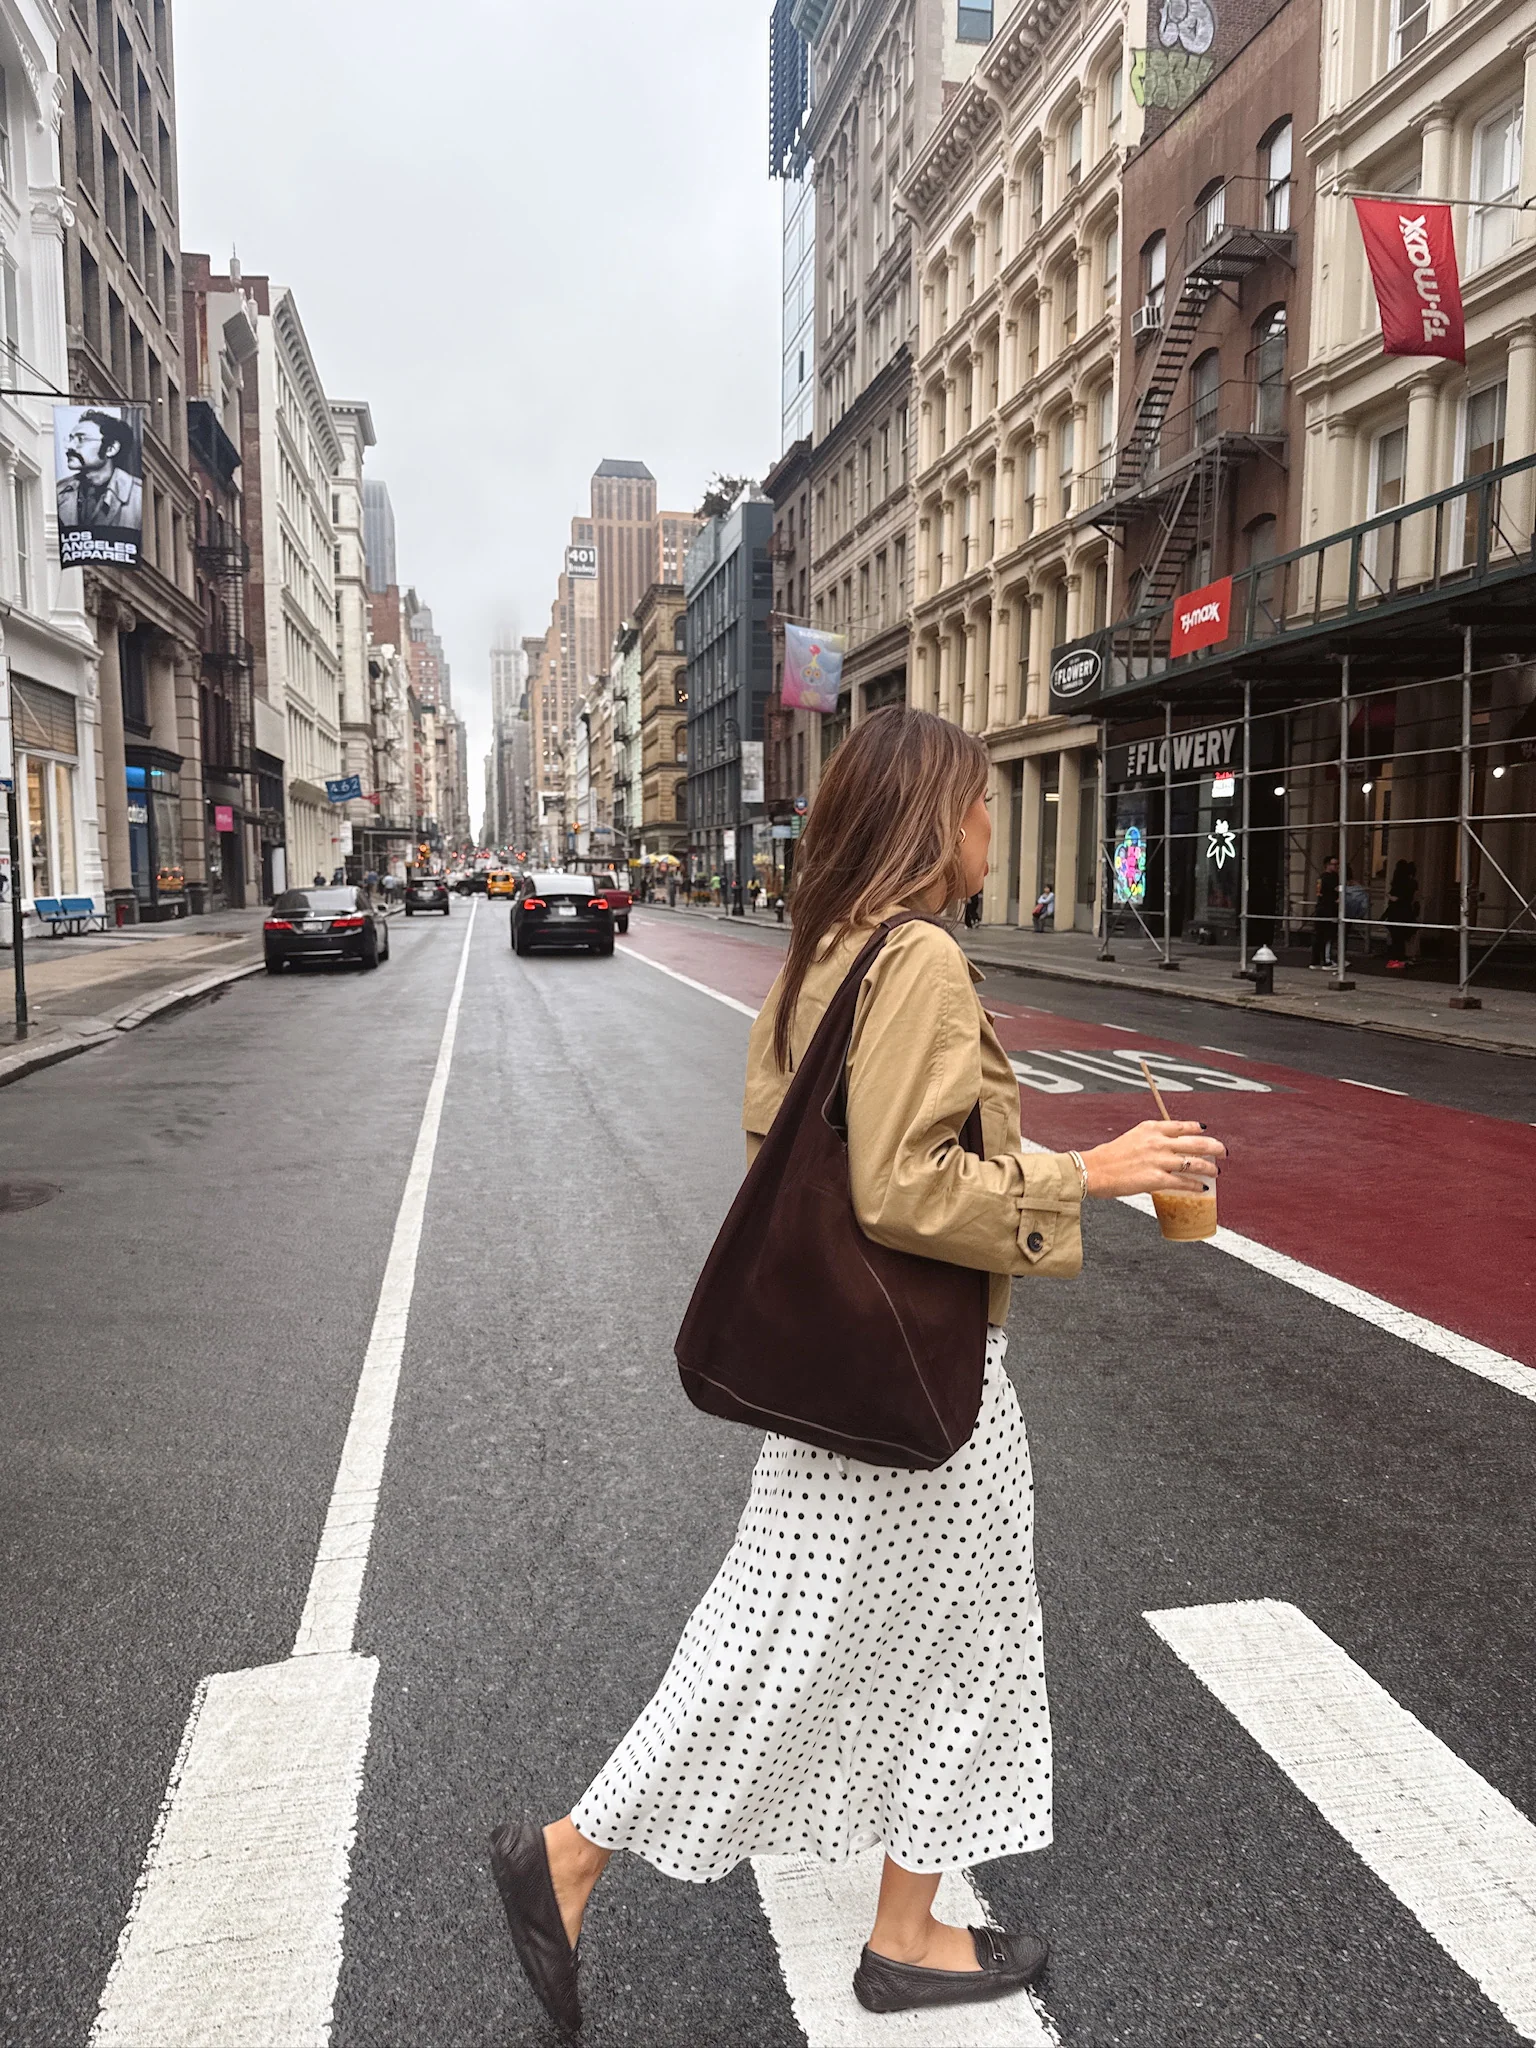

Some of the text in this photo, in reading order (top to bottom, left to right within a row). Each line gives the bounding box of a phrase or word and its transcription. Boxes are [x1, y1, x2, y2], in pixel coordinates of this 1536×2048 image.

[61, 531, 92, 543] LOS
[61, 540, 137, 555] ANGELES
[62, 550, 137, 564] APPAREL
[569, 549, 594, 563] 401
[1057, 657, 1095, 686] FLOWERY
[1127, 727, 1237, 777] THE FLOWERY
